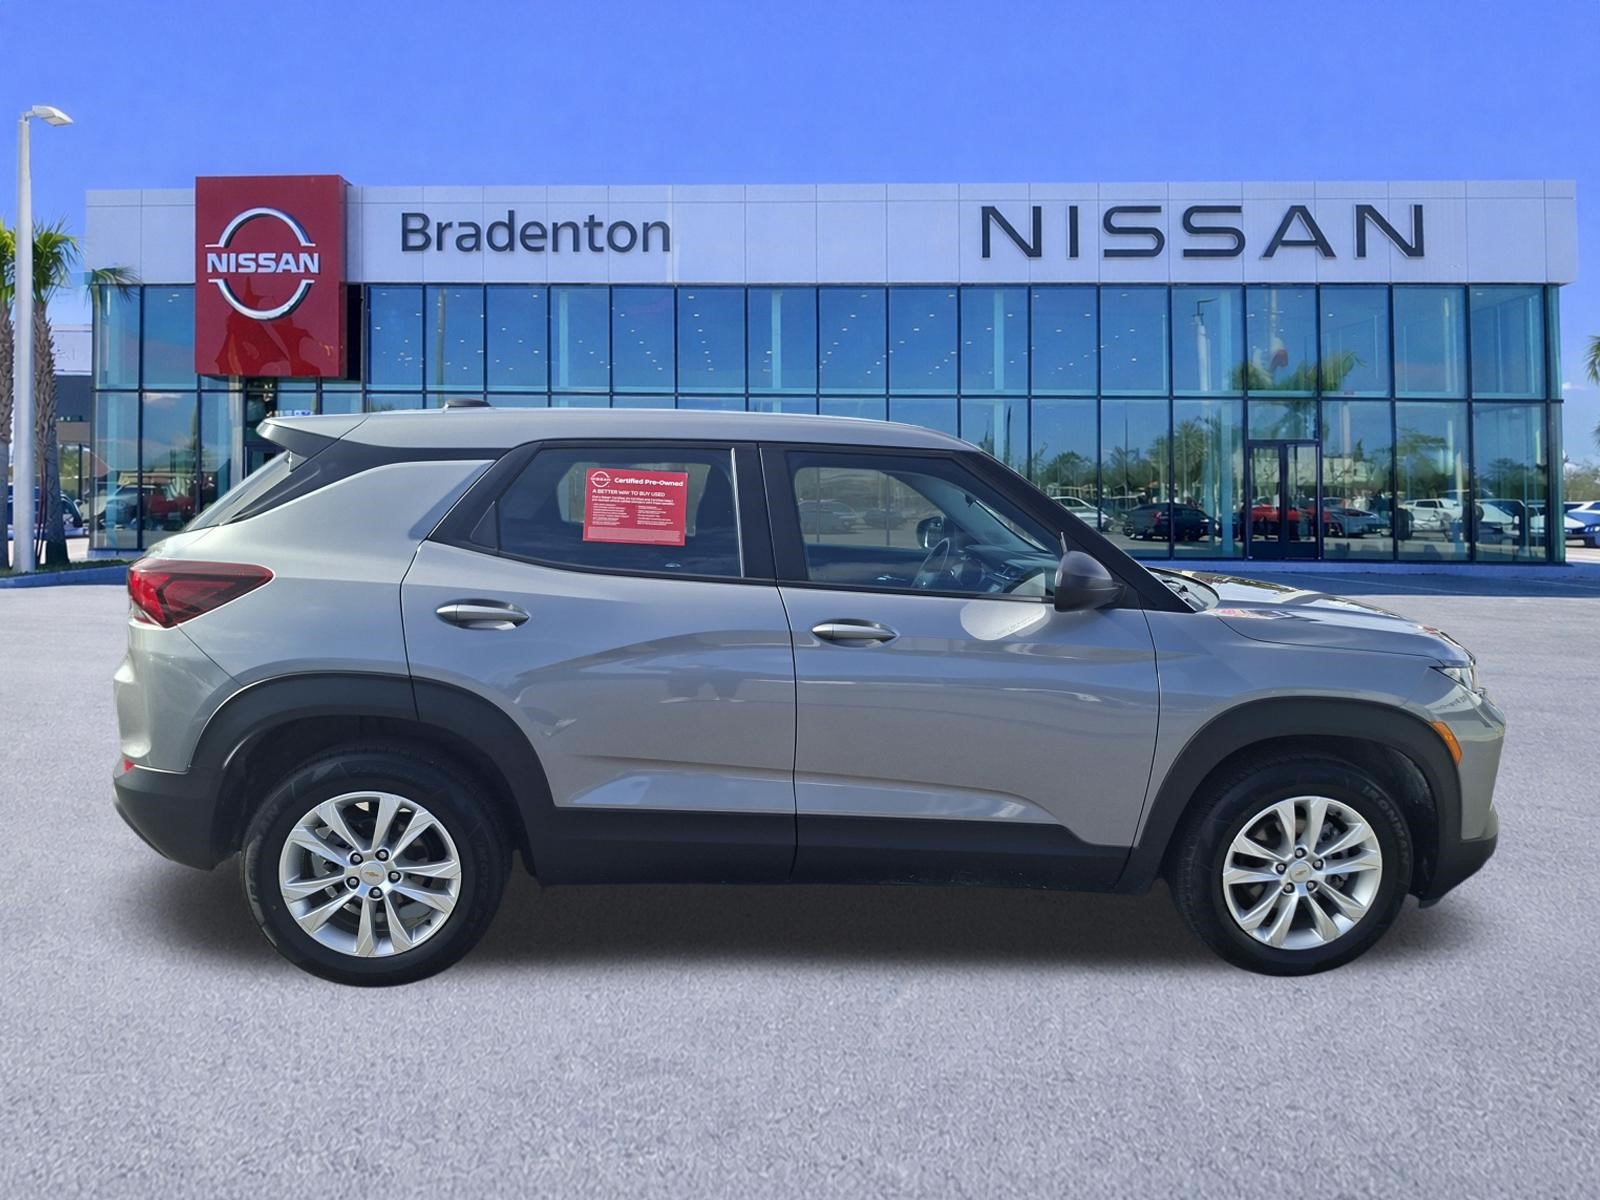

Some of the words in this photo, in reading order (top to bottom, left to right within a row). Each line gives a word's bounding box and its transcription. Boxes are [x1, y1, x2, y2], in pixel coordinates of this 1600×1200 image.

[400, 209, 671, 253] Bradenton
[980, 204, 1425, 259] NISSAN
[205, 252, 320, 274] NISSAN
[614, 477, 644, 486] Certified
[644, 479, 684, 487] Pre-Owned
